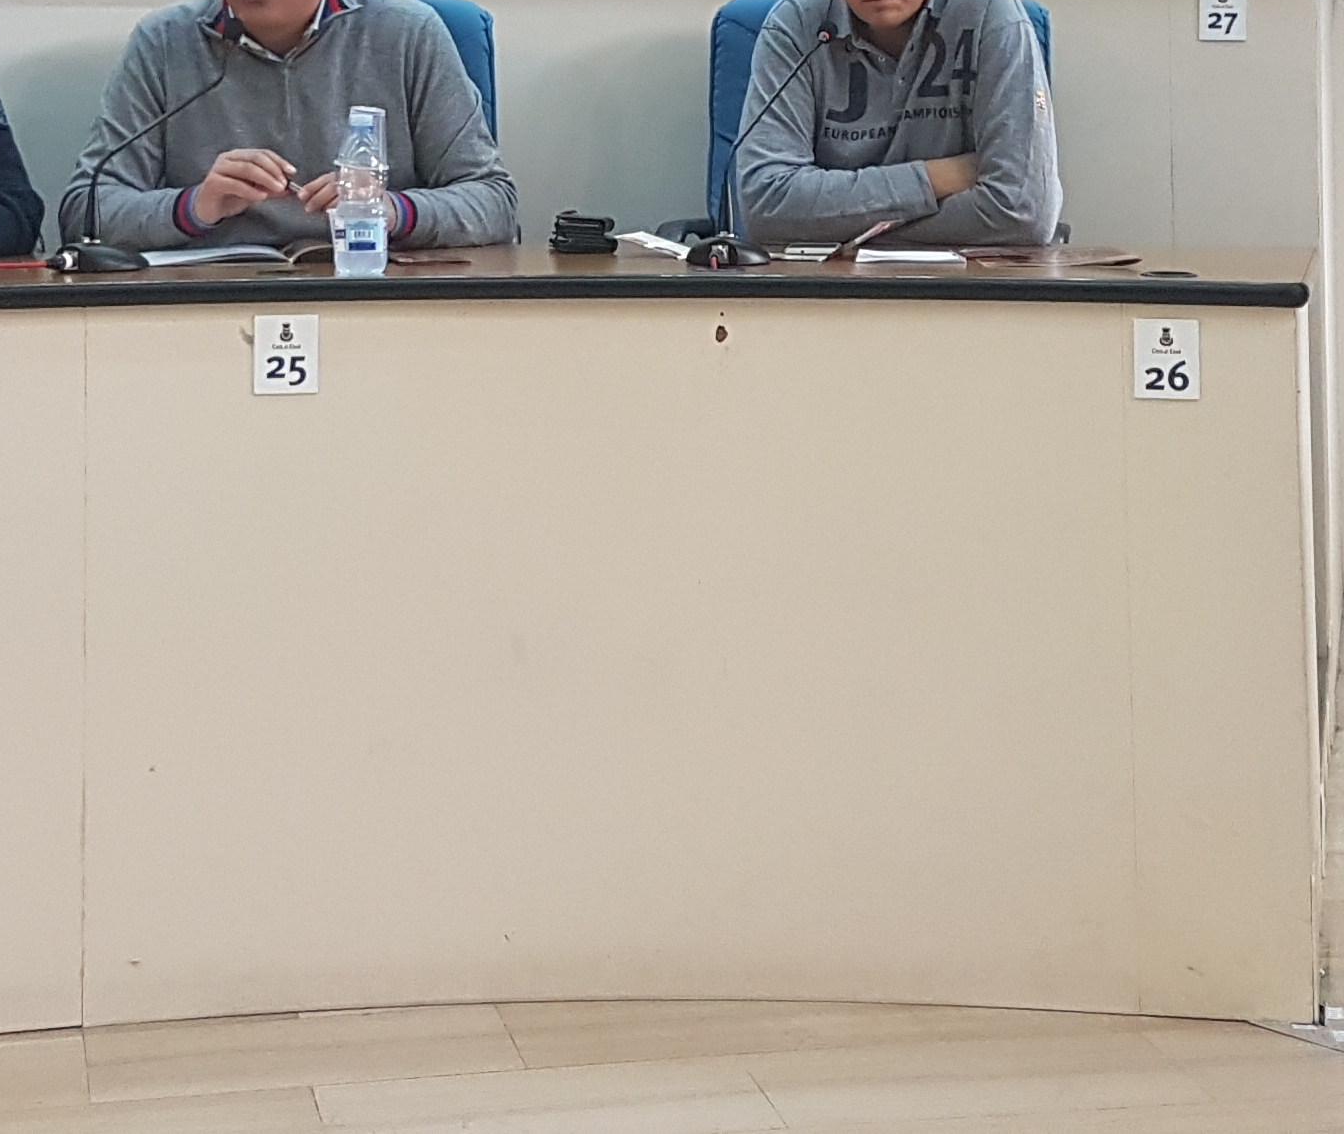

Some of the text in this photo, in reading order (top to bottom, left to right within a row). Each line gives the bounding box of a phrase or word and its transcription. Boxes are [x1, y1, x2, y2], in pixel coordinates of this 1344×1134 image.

[1208, 13, 1238, 35] 27
[266, 356, 306, 386] 25
[1145, 360, 1189, 391] 26
